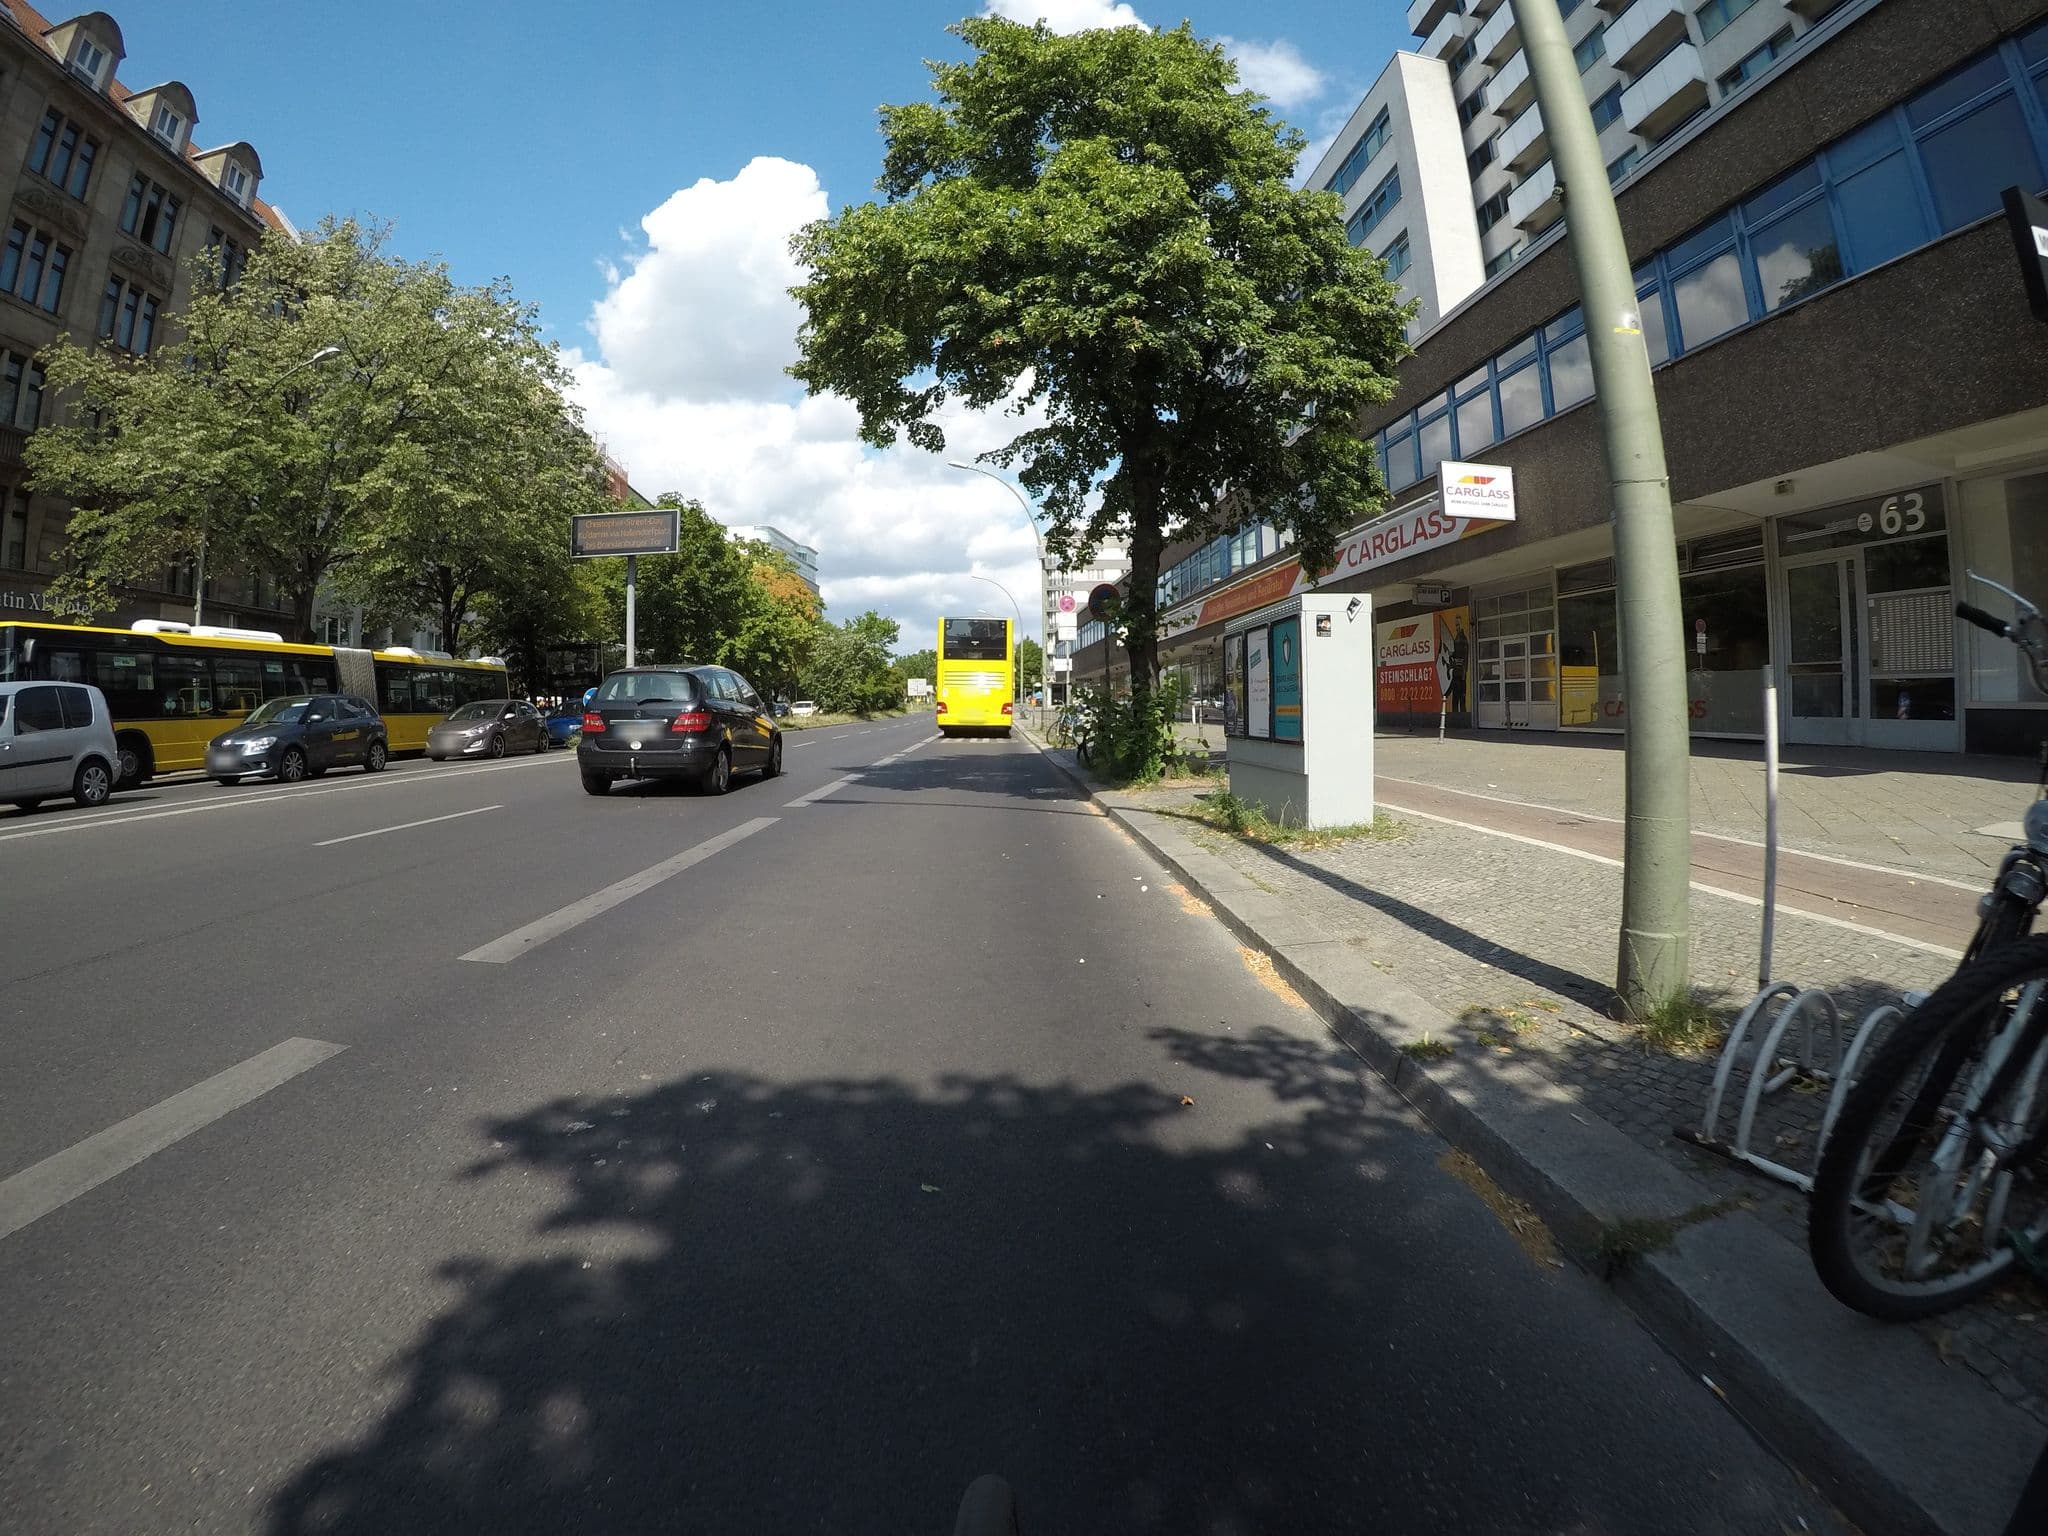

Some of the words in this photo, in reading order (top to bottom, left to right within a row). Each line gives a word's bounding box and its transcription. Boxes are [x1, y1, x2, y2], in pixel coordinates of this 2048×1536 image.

[1446, 486, 1510, 500] CARGLASS
[1880, 493, 1925, 534] 63
[1347, 510, 1457, 567] CARGLASS
[1380, 640, 1430, 658] CARGLASS
[1380, 667, 1432, 684] STEINSCHLAG?
